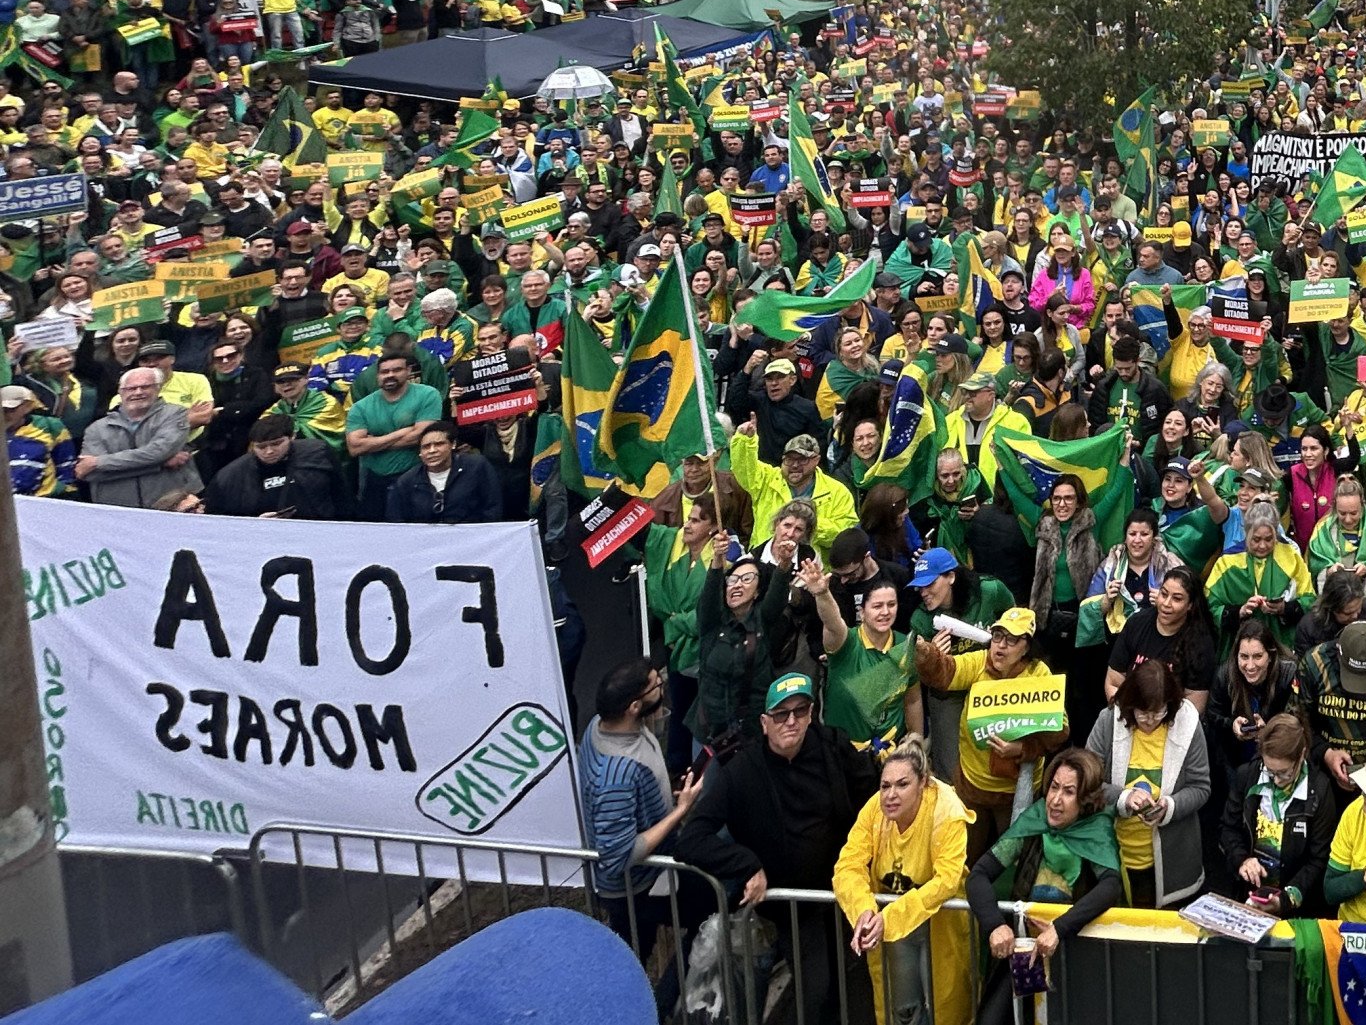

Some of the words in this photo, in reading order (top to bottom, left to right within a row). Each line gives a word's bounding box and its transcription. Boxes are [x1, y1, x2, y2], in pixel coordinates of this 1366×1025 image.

[1253, 134, 1314, 158] MAGNITSKY
[1316, 136, 1324, 159] É
[0, 175, 82, 201] Jessé
[504, 202, 558, 223] BOLSONARO
[170, 266, 213, 278] ANISTIA
[105, 284, 148, 302] ANISTIA
[111, 303, 139, 326] já
[1224, 299, 1249, 310] MORAES
[1224, 309, 1249, 320] DITADOR
[1213, 322, 1254, 336] IMPEACHMENT
[472, 353, 507, 370] MORAES
[473, 363, 509, 380] DITADOR
[462, 400, 520, 419] IMPEACHMENT
[522, 393, 533, 406] JÁ
[579, 496, 603, 522] MORAES
[584, 506, 615, 532] DITADOR
[590, 514, 640, 557] IMPEACHMENT
[635, 503, 647, 517] JÁ
[973, 689, 1061, 708] BOLSONARO
[1346, 710, 1358, 719] DO
[973, 717, 1037, 742] ELEGÍVEL
[1041, 717, 1058, 728] JÁ
